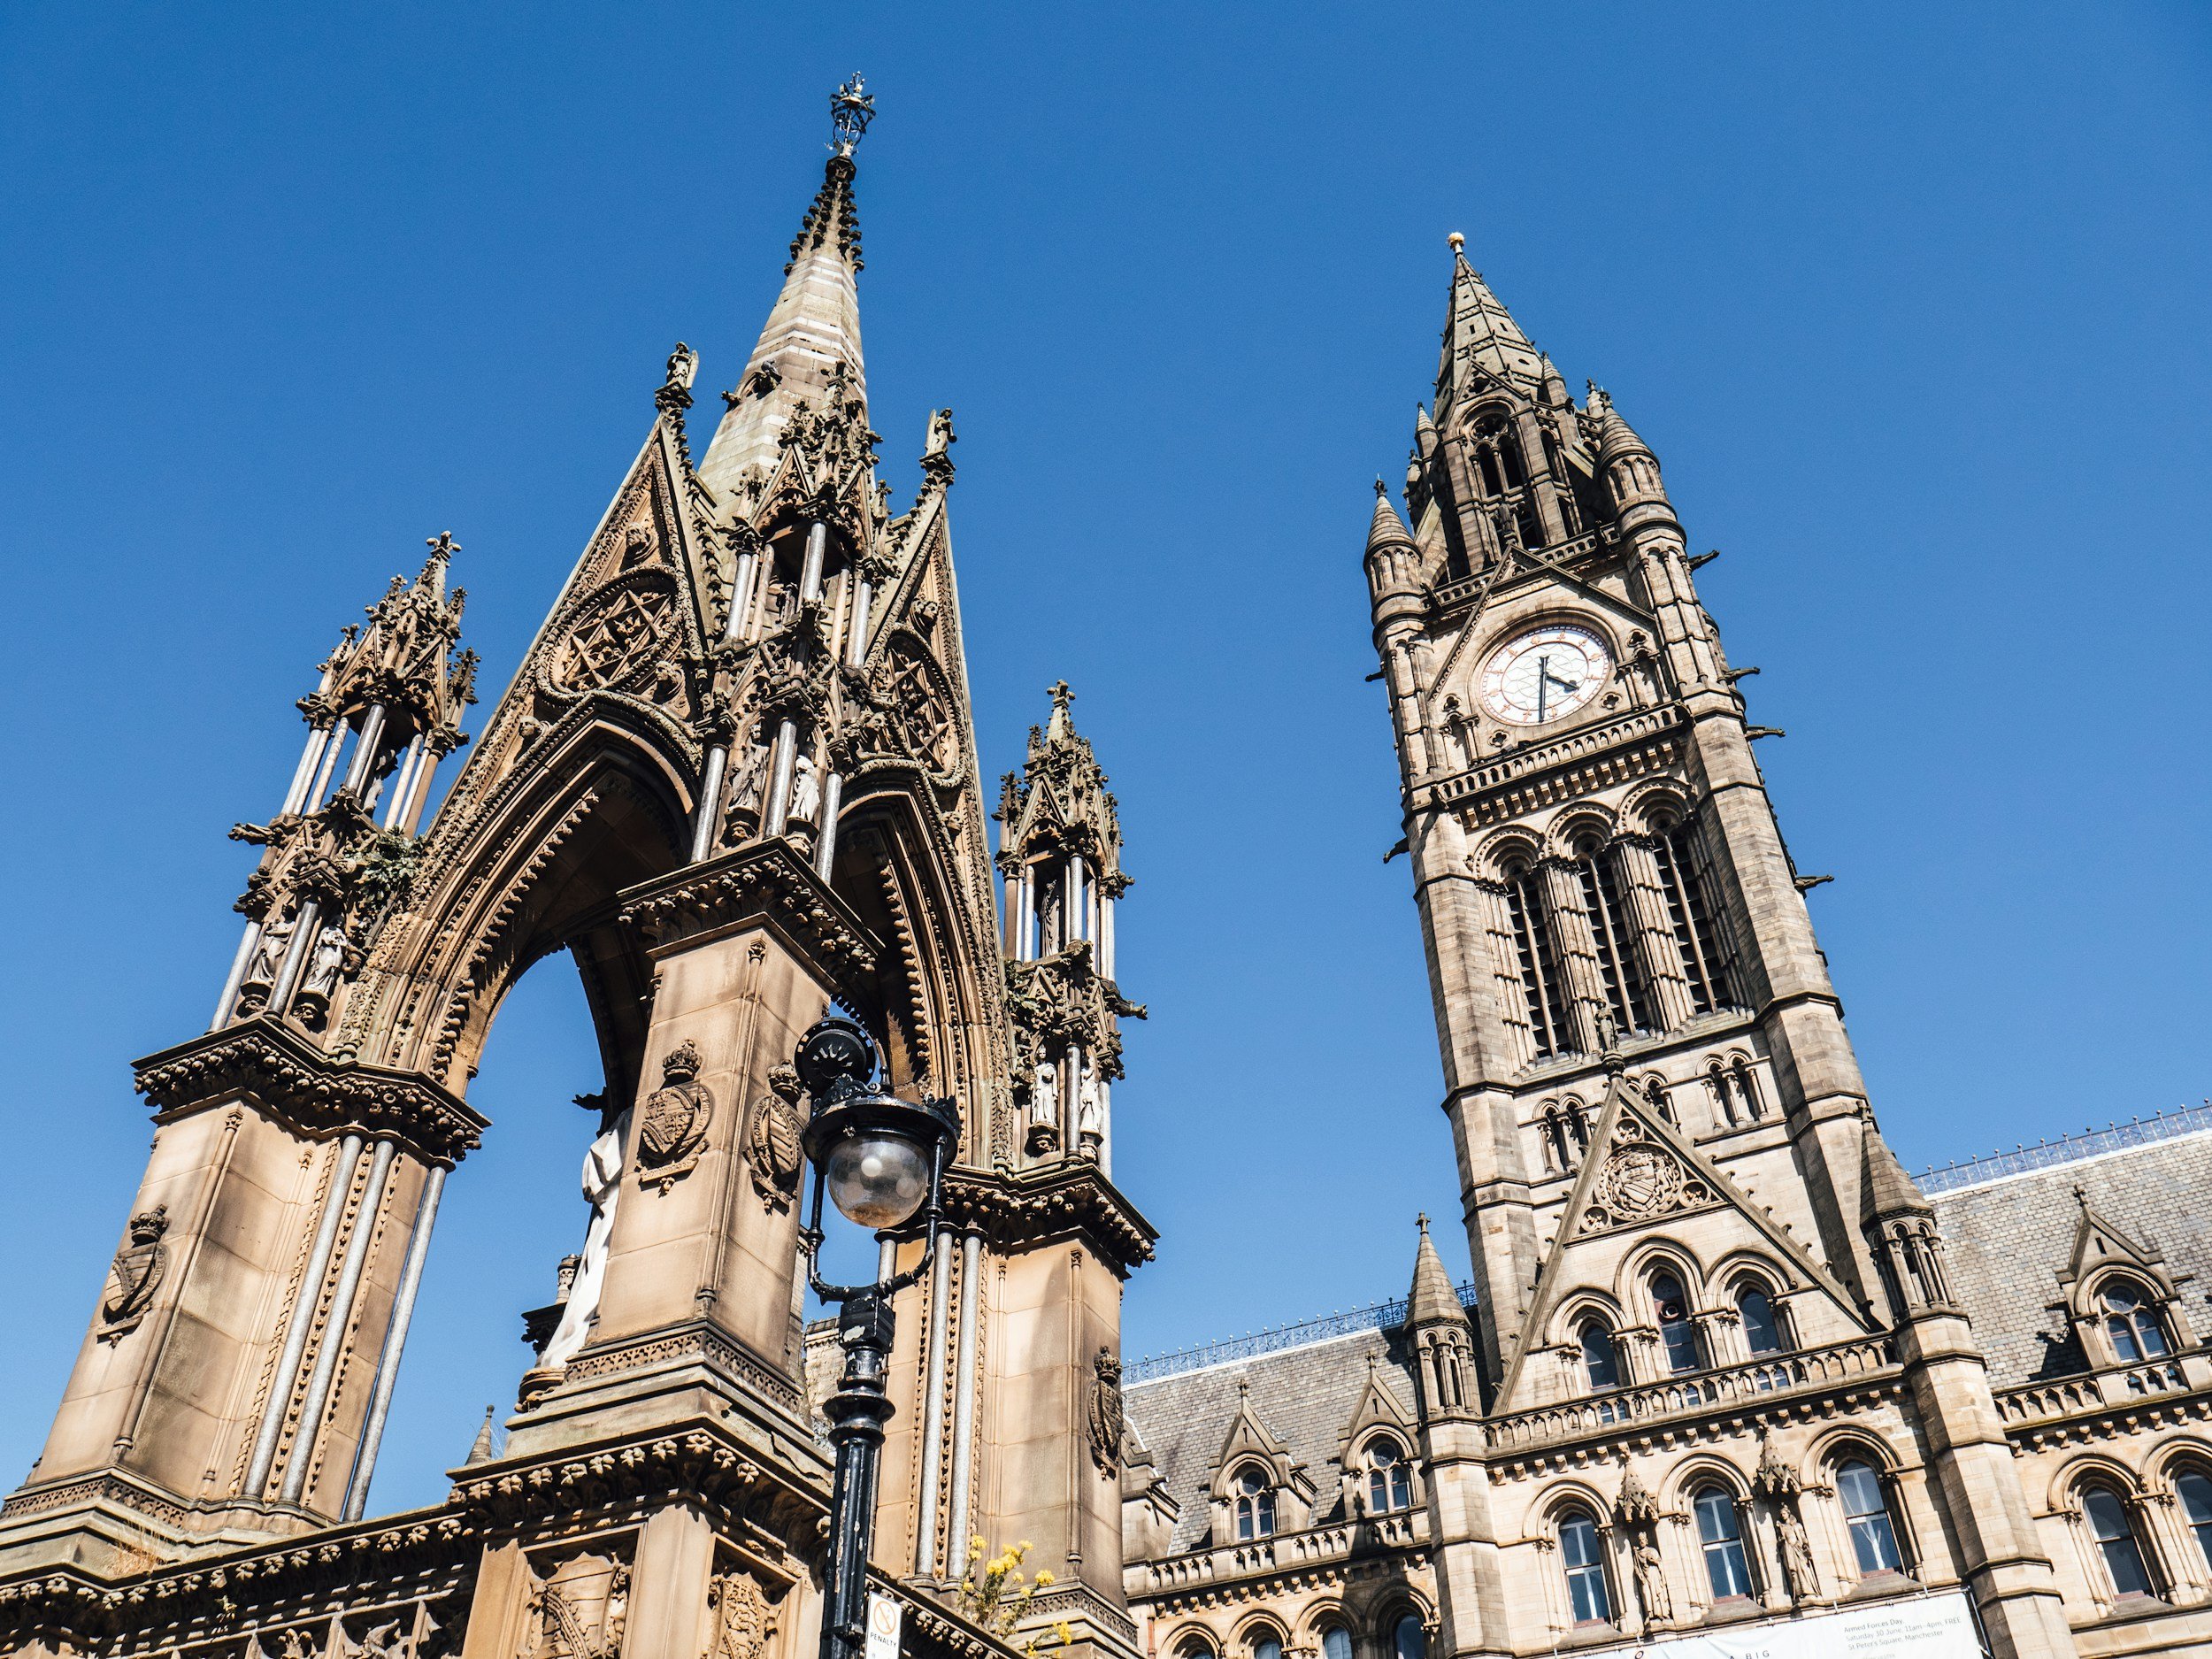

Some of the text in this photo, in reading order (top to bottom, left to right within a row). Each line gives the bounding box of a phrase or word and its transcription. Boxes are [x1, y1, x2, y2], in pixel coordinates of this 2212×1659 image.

[870, 1632, 896, 1647] PENALTY
[1904, 1631, 1943, 1641] Manchester
[1746, 1650, 1770, 1659] BIG
